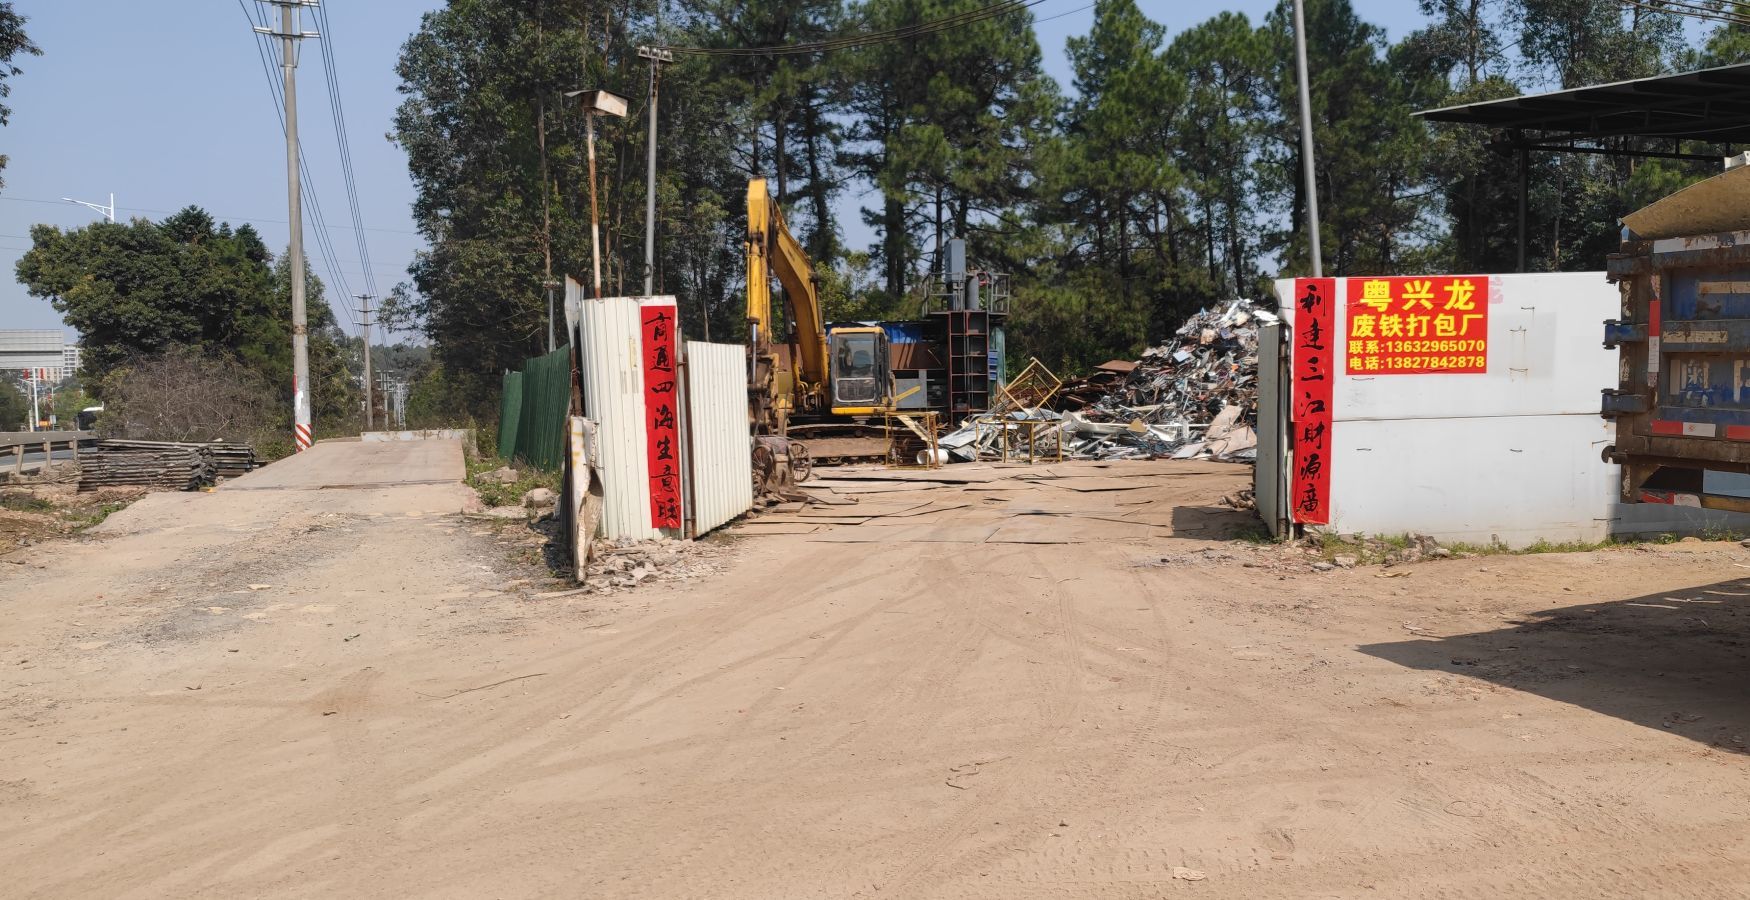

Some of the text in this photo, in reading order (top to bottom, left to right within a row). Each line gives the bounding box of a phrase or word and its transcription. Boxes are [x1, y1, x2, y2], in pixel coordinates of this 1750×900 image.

[1360, 279, 1476, 312] 粤兴龙
[1351, 313, 1483, 337] 废铁打包厂
[1349, 340, 1485, 354] 联系:13632965070
[1349, 356, 1485, 370] 电话:13827842878
